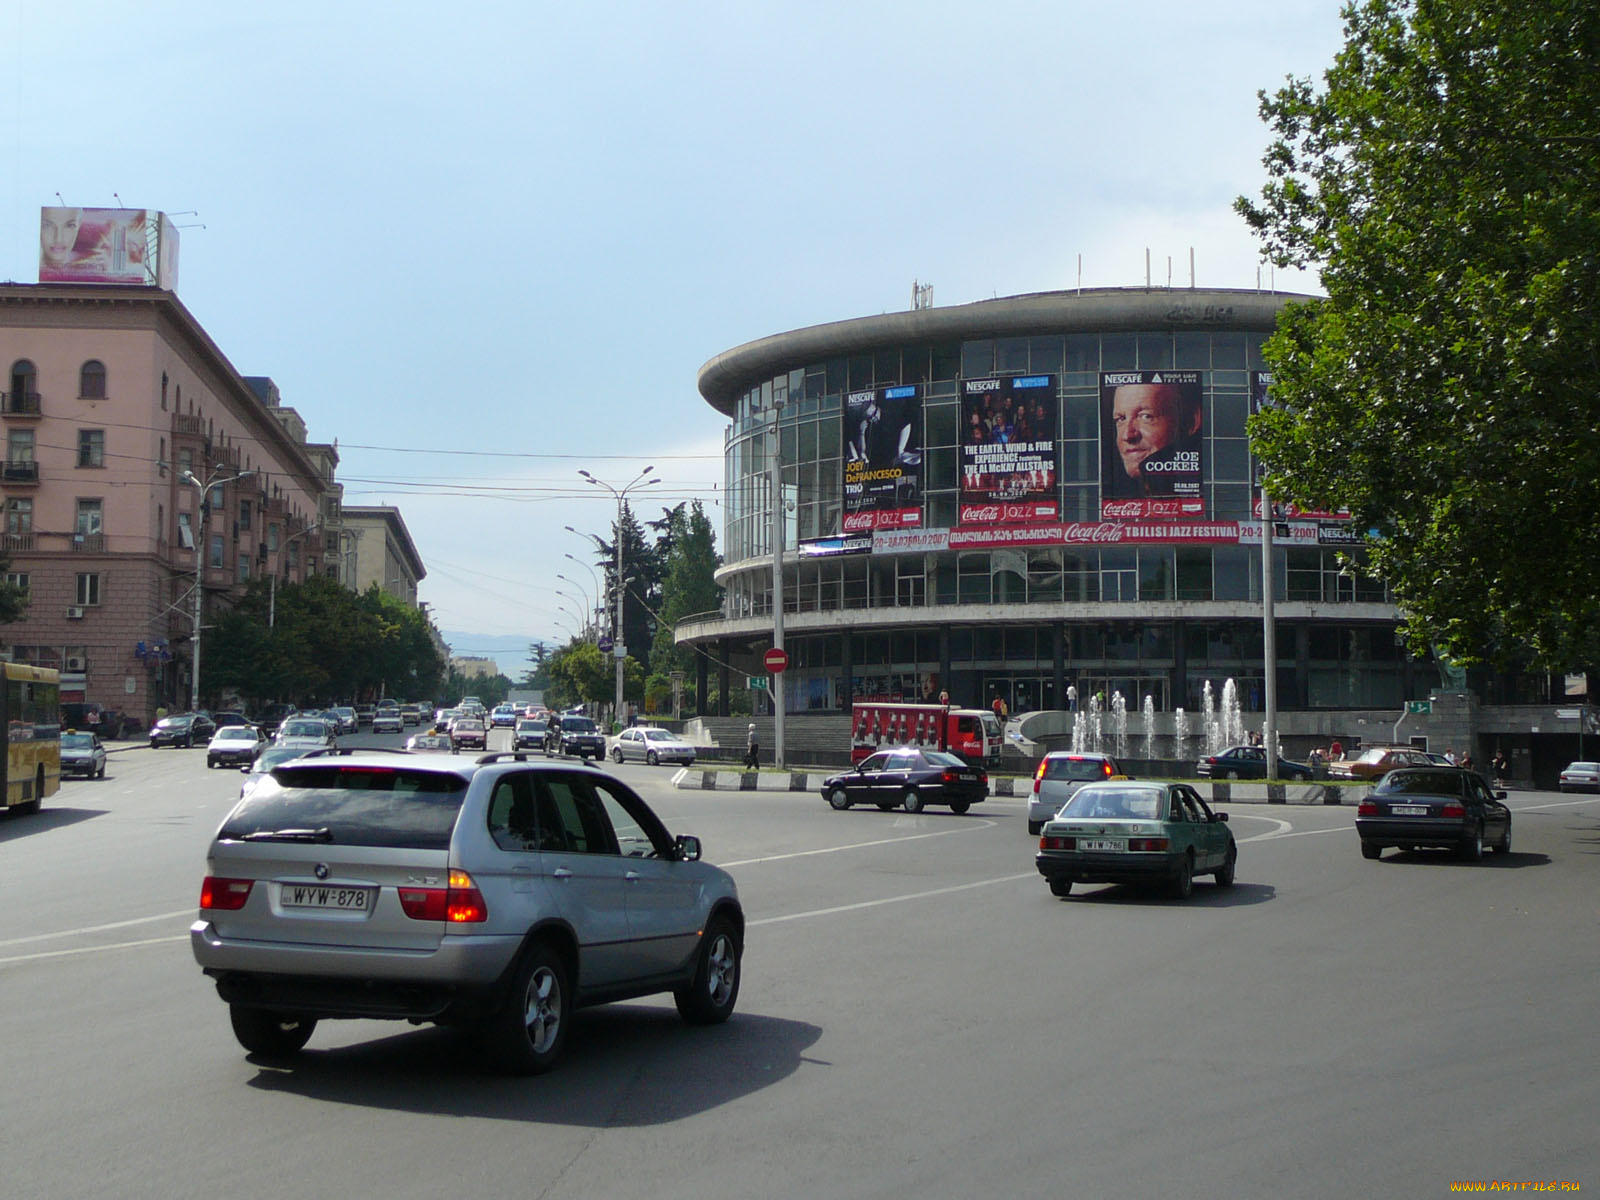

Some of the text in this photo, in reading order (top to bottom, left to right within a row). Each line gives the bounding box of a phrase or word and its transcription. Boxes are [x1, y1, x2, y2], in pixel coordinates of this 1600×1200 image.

[964, 446, 978, 455] THE
[1005, 443, 1027, 452] WIND
[1028, 443, 1034, 452] &
[1036, 441, 1053, 451] FIRE
[975, 453, 1018, 464] EXPERIENCE
[1174, 452, 1199, 461] JOE
[846, 461, 864, 472] JOEY
[964, 460, 1054, 474] THE AL McKAY ALLSTARS
[1145, 461, 1199, 471] COCKER
[846, 468, 902, 482] DeFRANCESCO
[846, 483, 863, 494] TRIO
[1125, 526, 1167, 537] TBILISI
[1169, 526, 1191, 537] JAZZ
[1193, 526, 1238, 537] FESTIVAL
[1294, 528, 1316, 538] 2007
[1132, 824, 1139, 832] D
